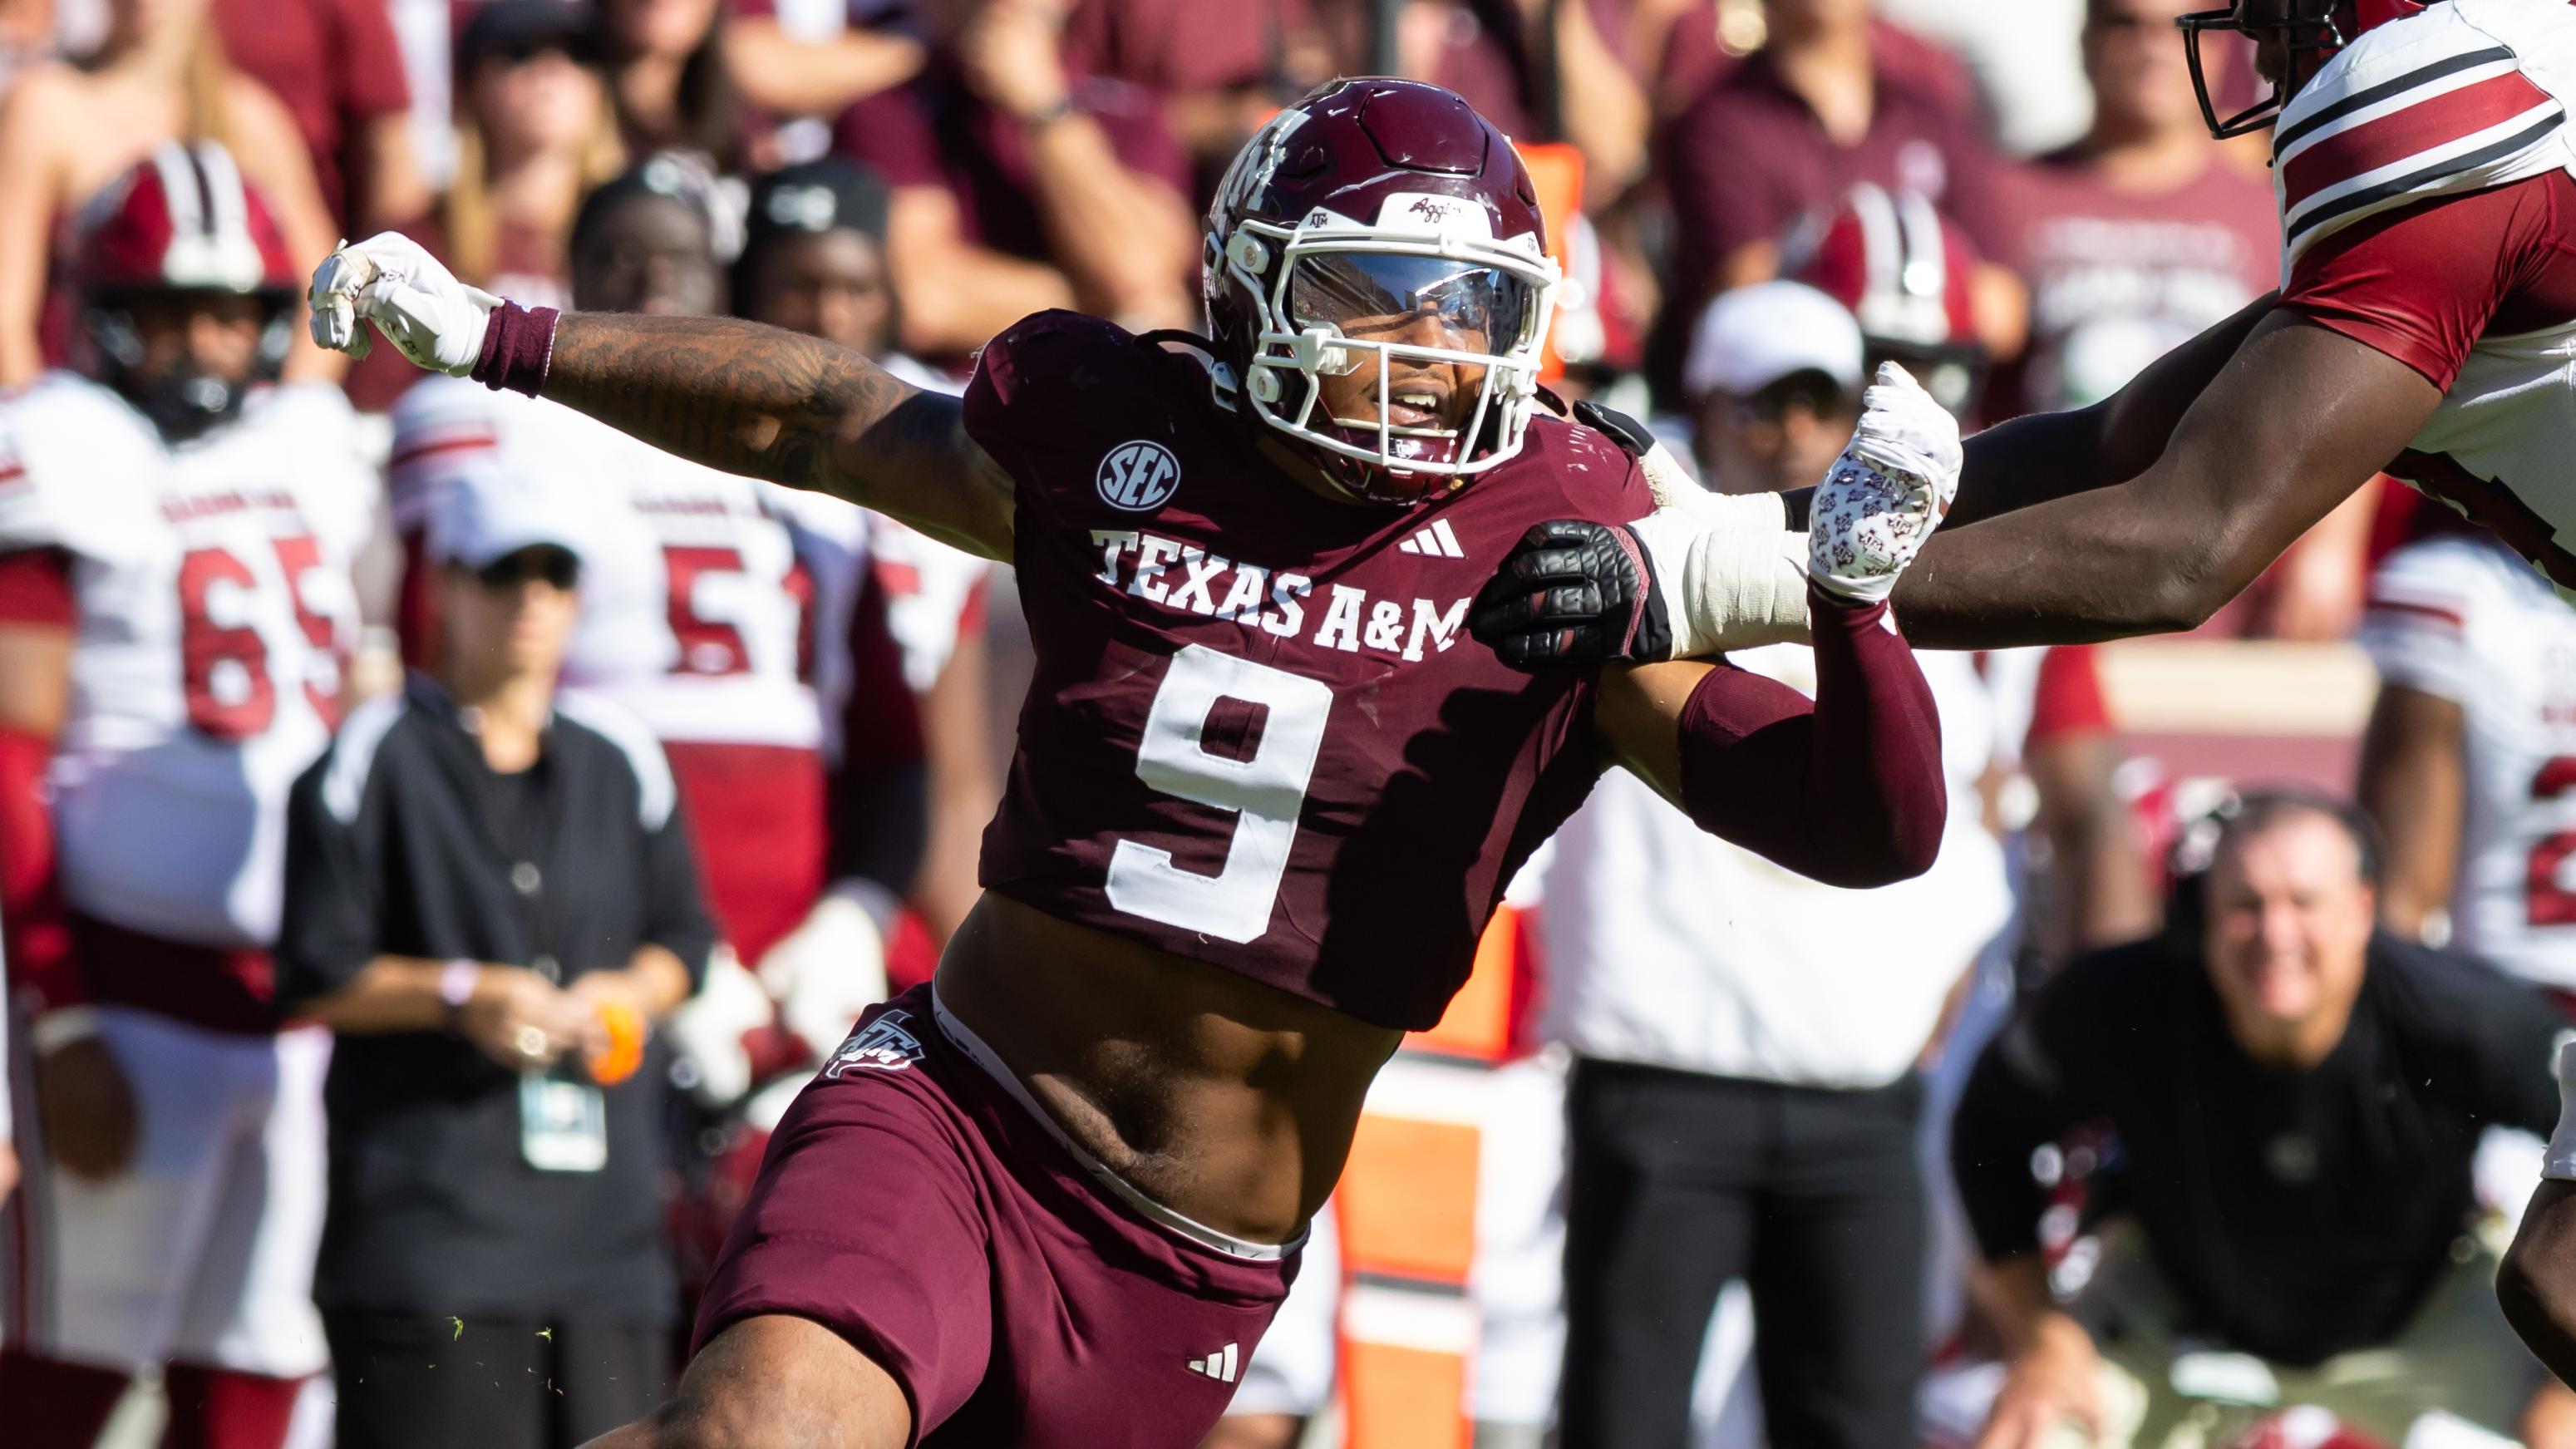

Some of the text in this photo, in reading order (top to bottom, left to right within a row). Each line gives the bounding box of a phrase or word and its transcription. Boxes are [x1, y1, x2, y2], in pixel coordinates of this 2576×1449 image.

[1408, 197, 1463, 224] Aggi
[1103, 446, 1175, 505] SEC
[1090, 530, 1471, 662] TEXAS A&M
[1105, 643, 1333, 944] 9
